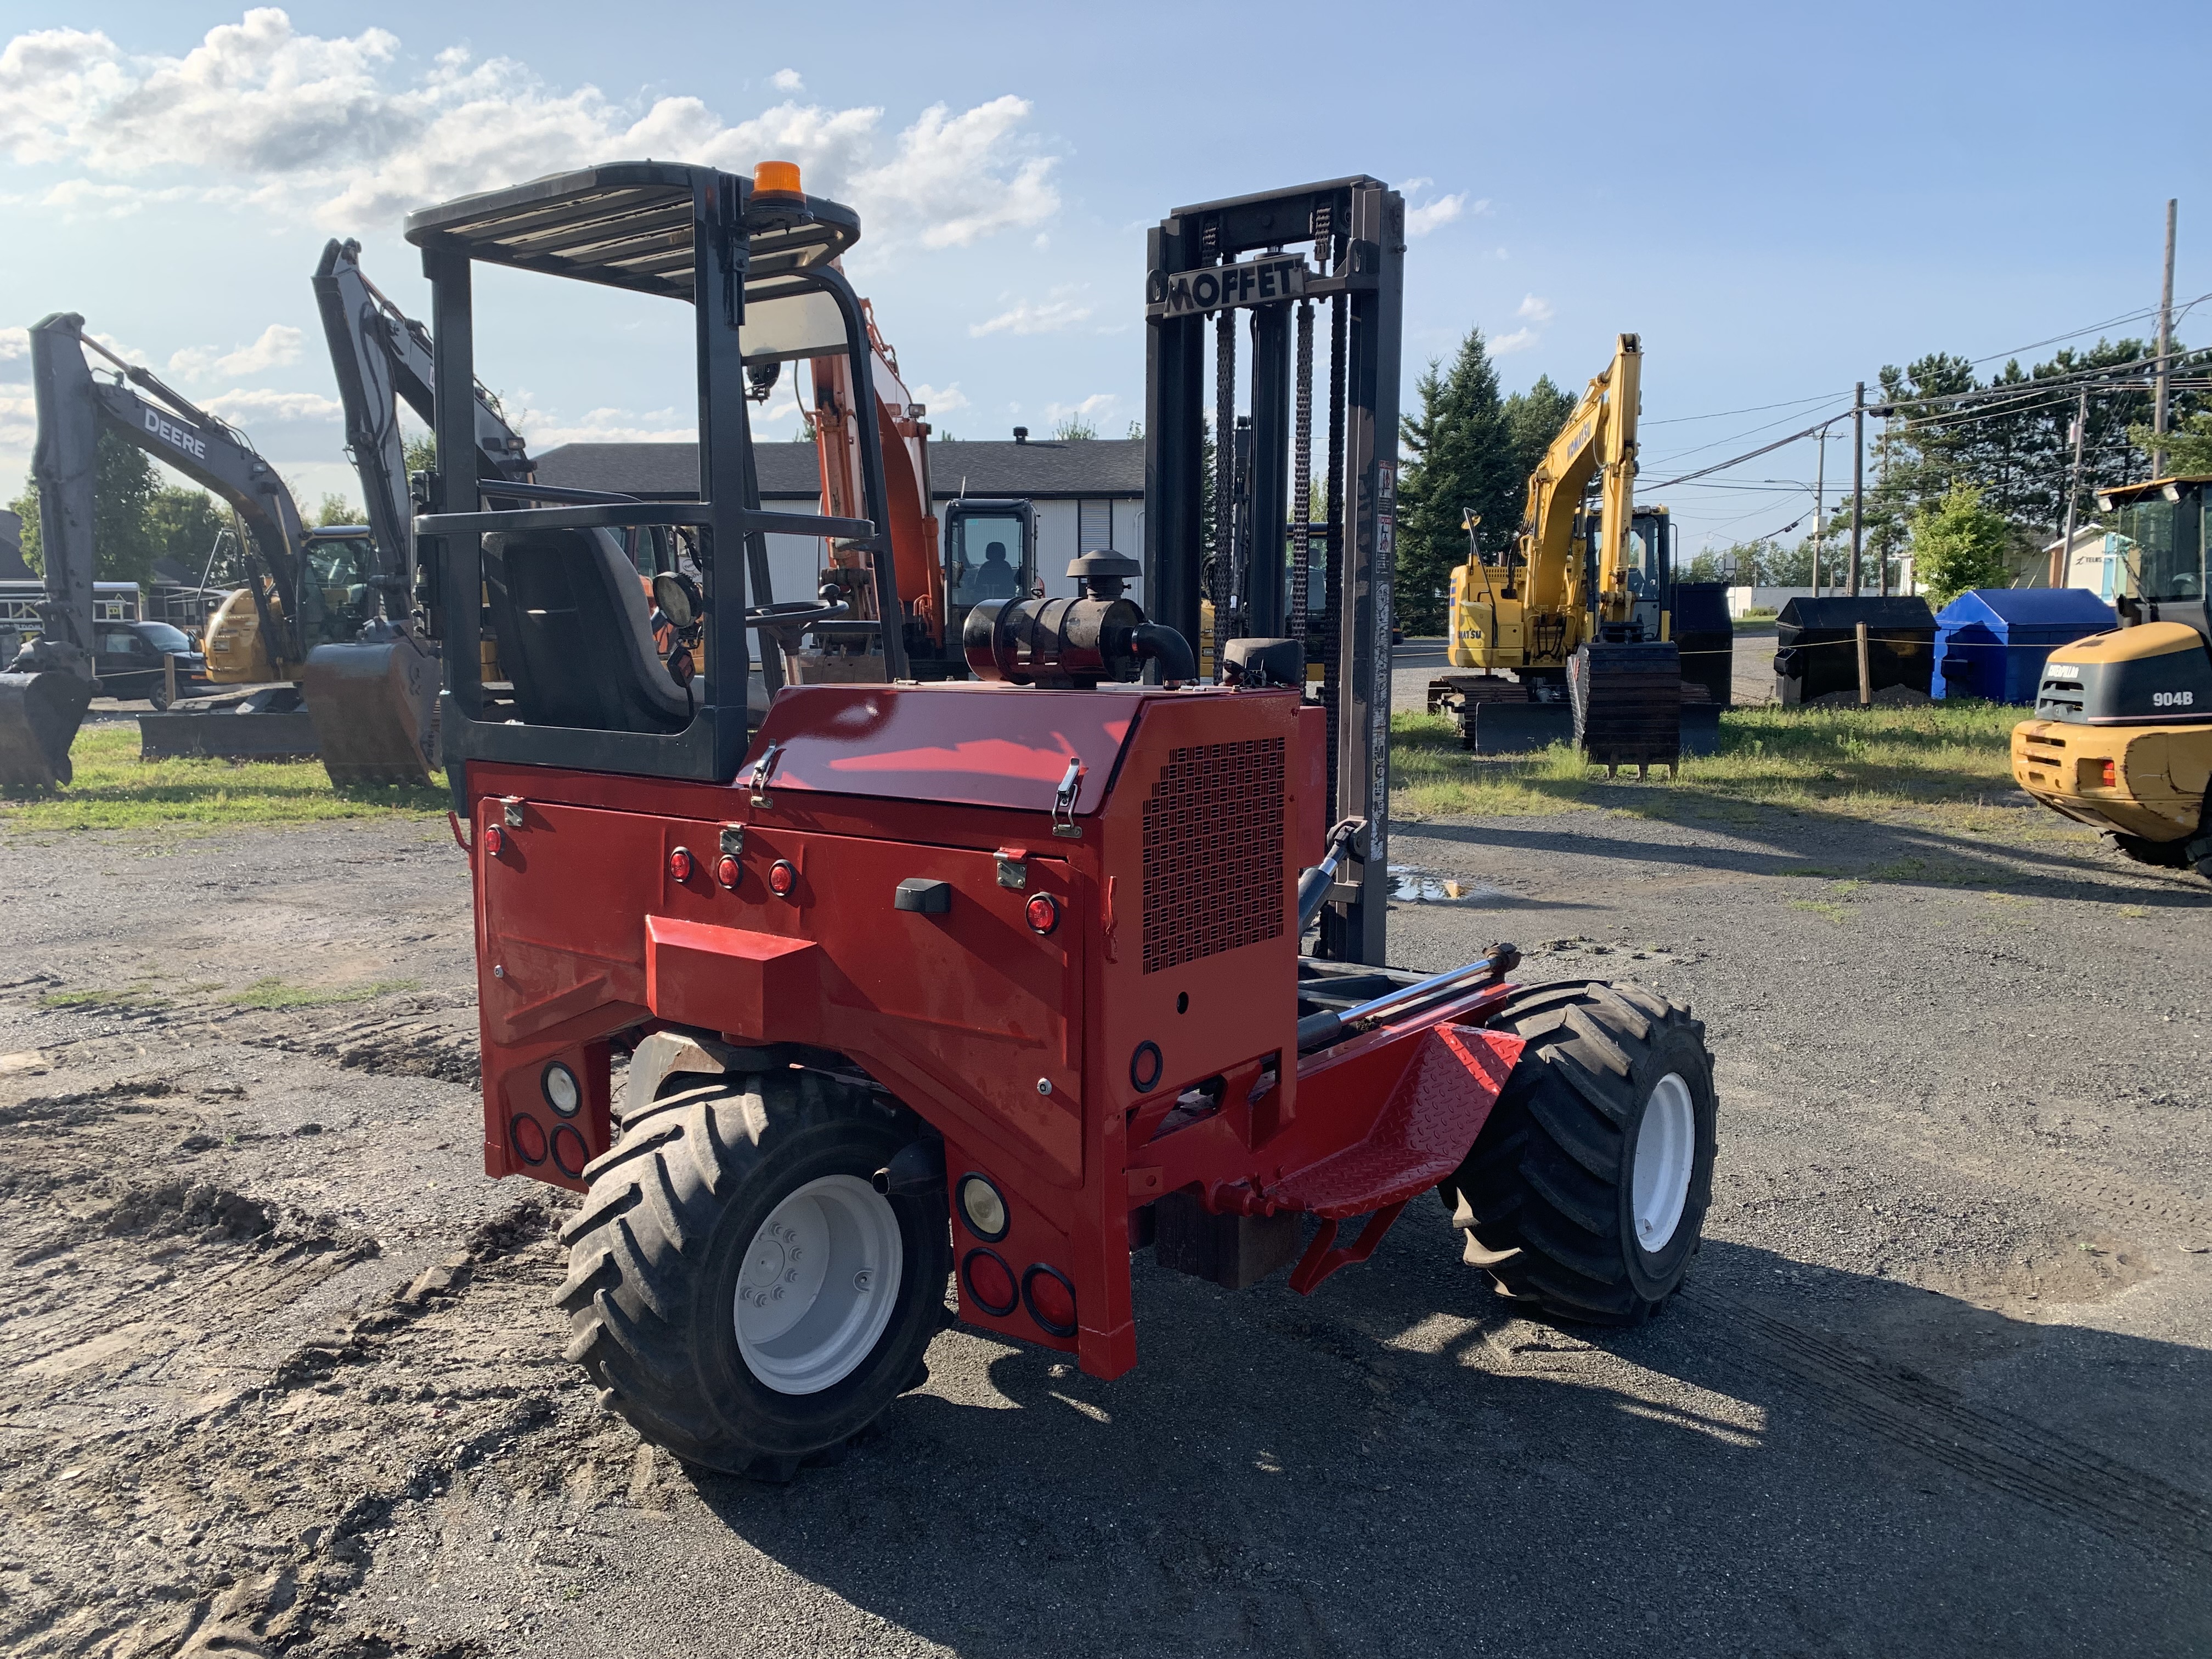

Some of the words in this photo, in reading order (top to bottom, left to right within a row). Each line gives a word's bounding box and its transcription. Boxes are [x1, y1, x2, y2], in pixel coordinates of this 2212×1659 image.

[145, 408, 206, 459] DEERE
[1567, 419, 1591, 462] KOMATSU
[1458, 628, 1482, 639] MATSU
[2047, 665, 2079, 678] CATERPILLAR
[2153, 691, 2193, 706] 904B
